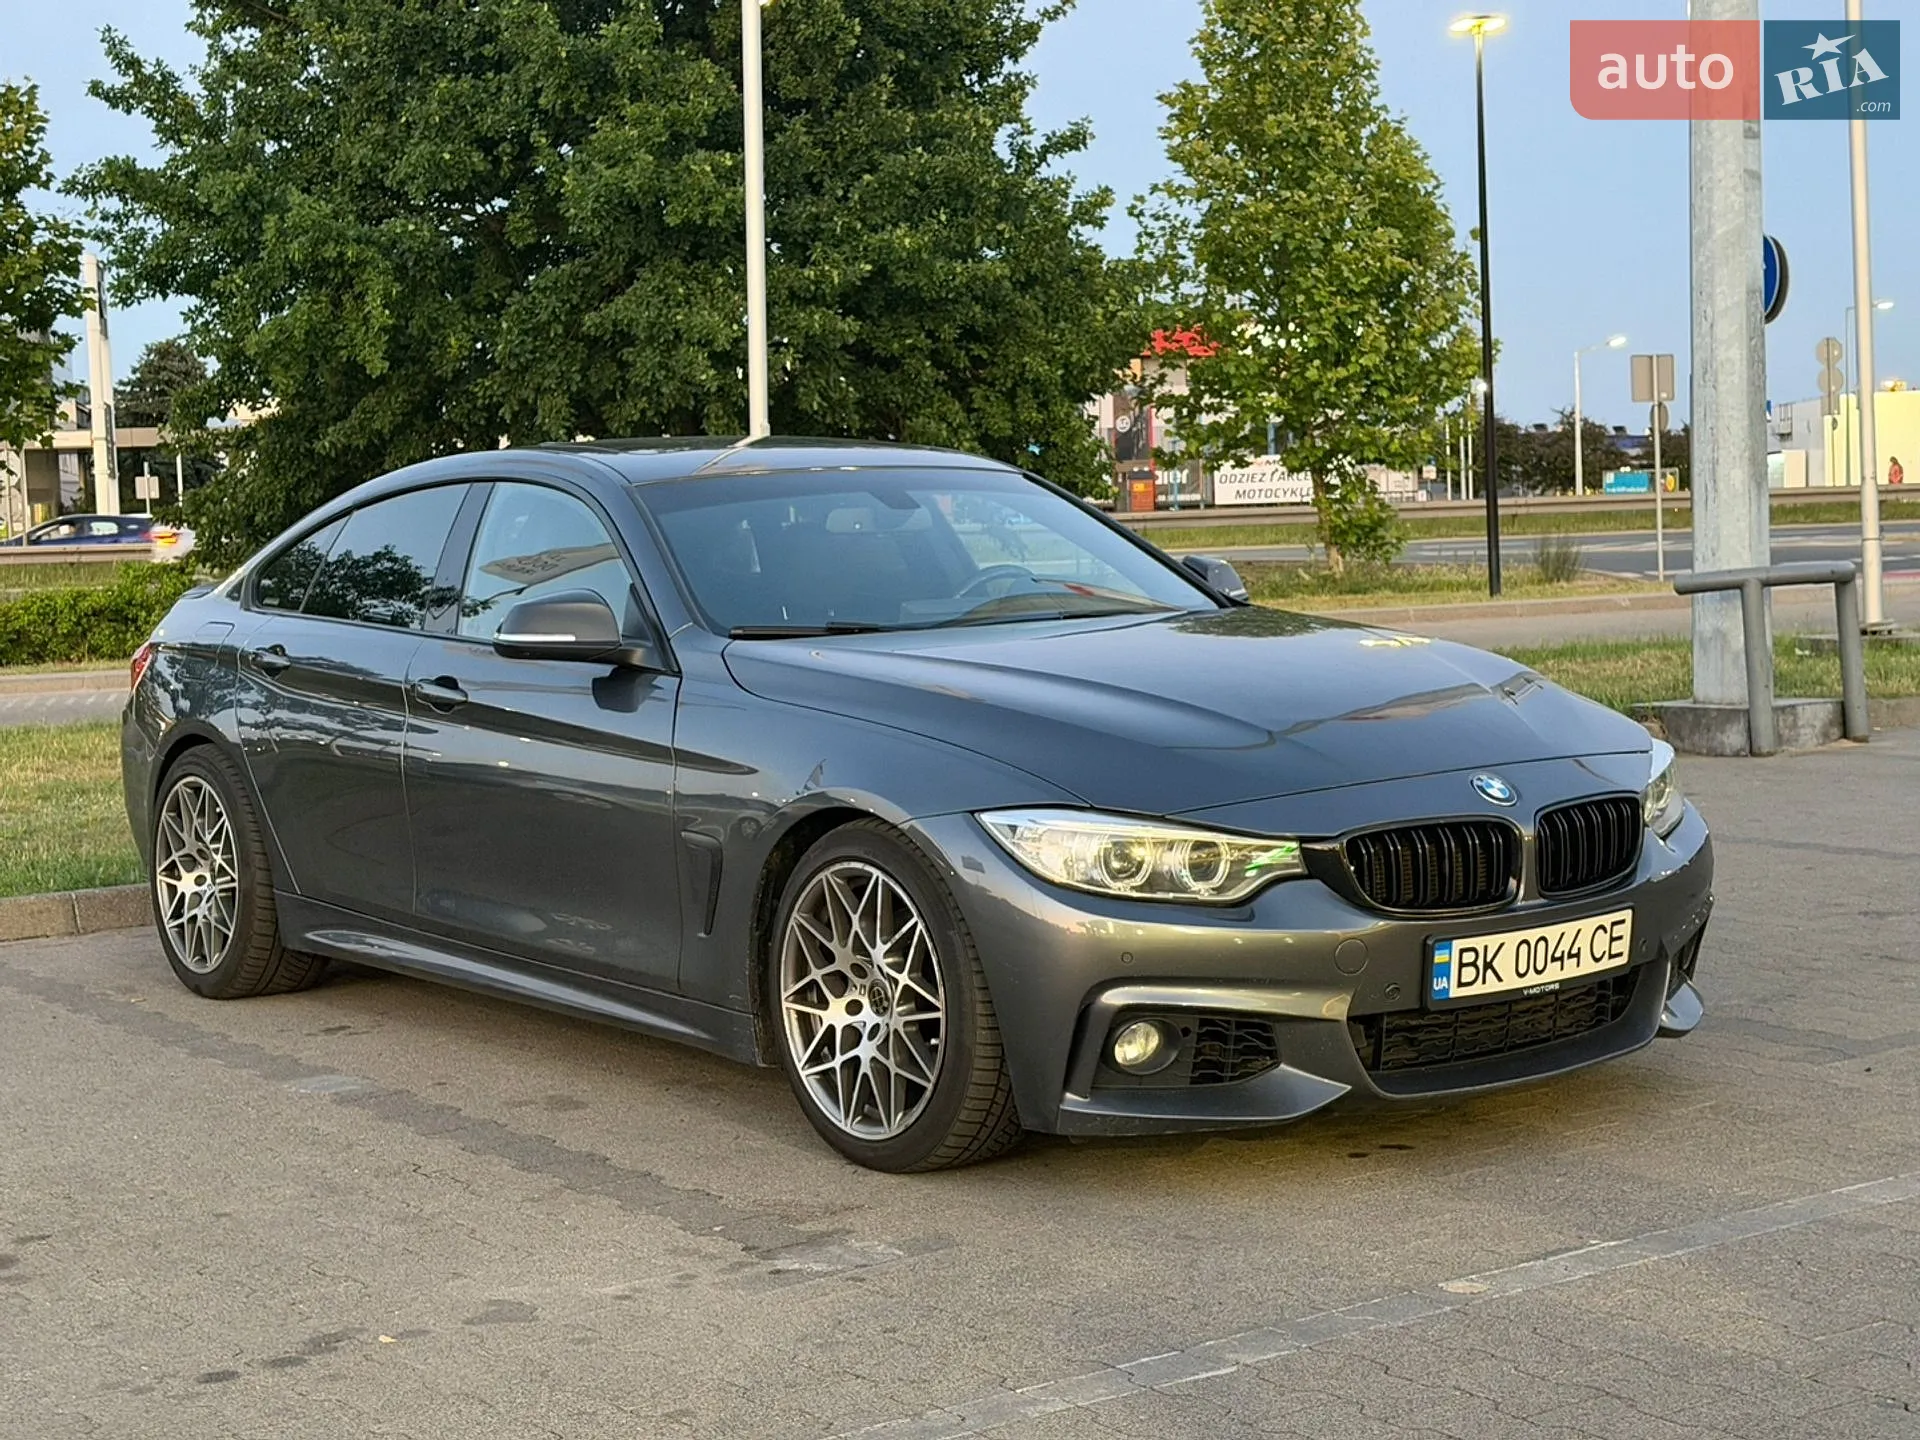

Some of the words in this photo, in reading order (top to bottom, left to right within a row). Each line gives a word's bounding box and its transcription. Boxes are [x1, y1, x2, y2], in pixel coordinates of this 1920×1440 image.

[1457, 942, 1505, 989] BK
[1515, 928, 1582, 978] 0044
[1590, 918, 1627, 963] CE
[1433, 976, 1449, 991] UA
